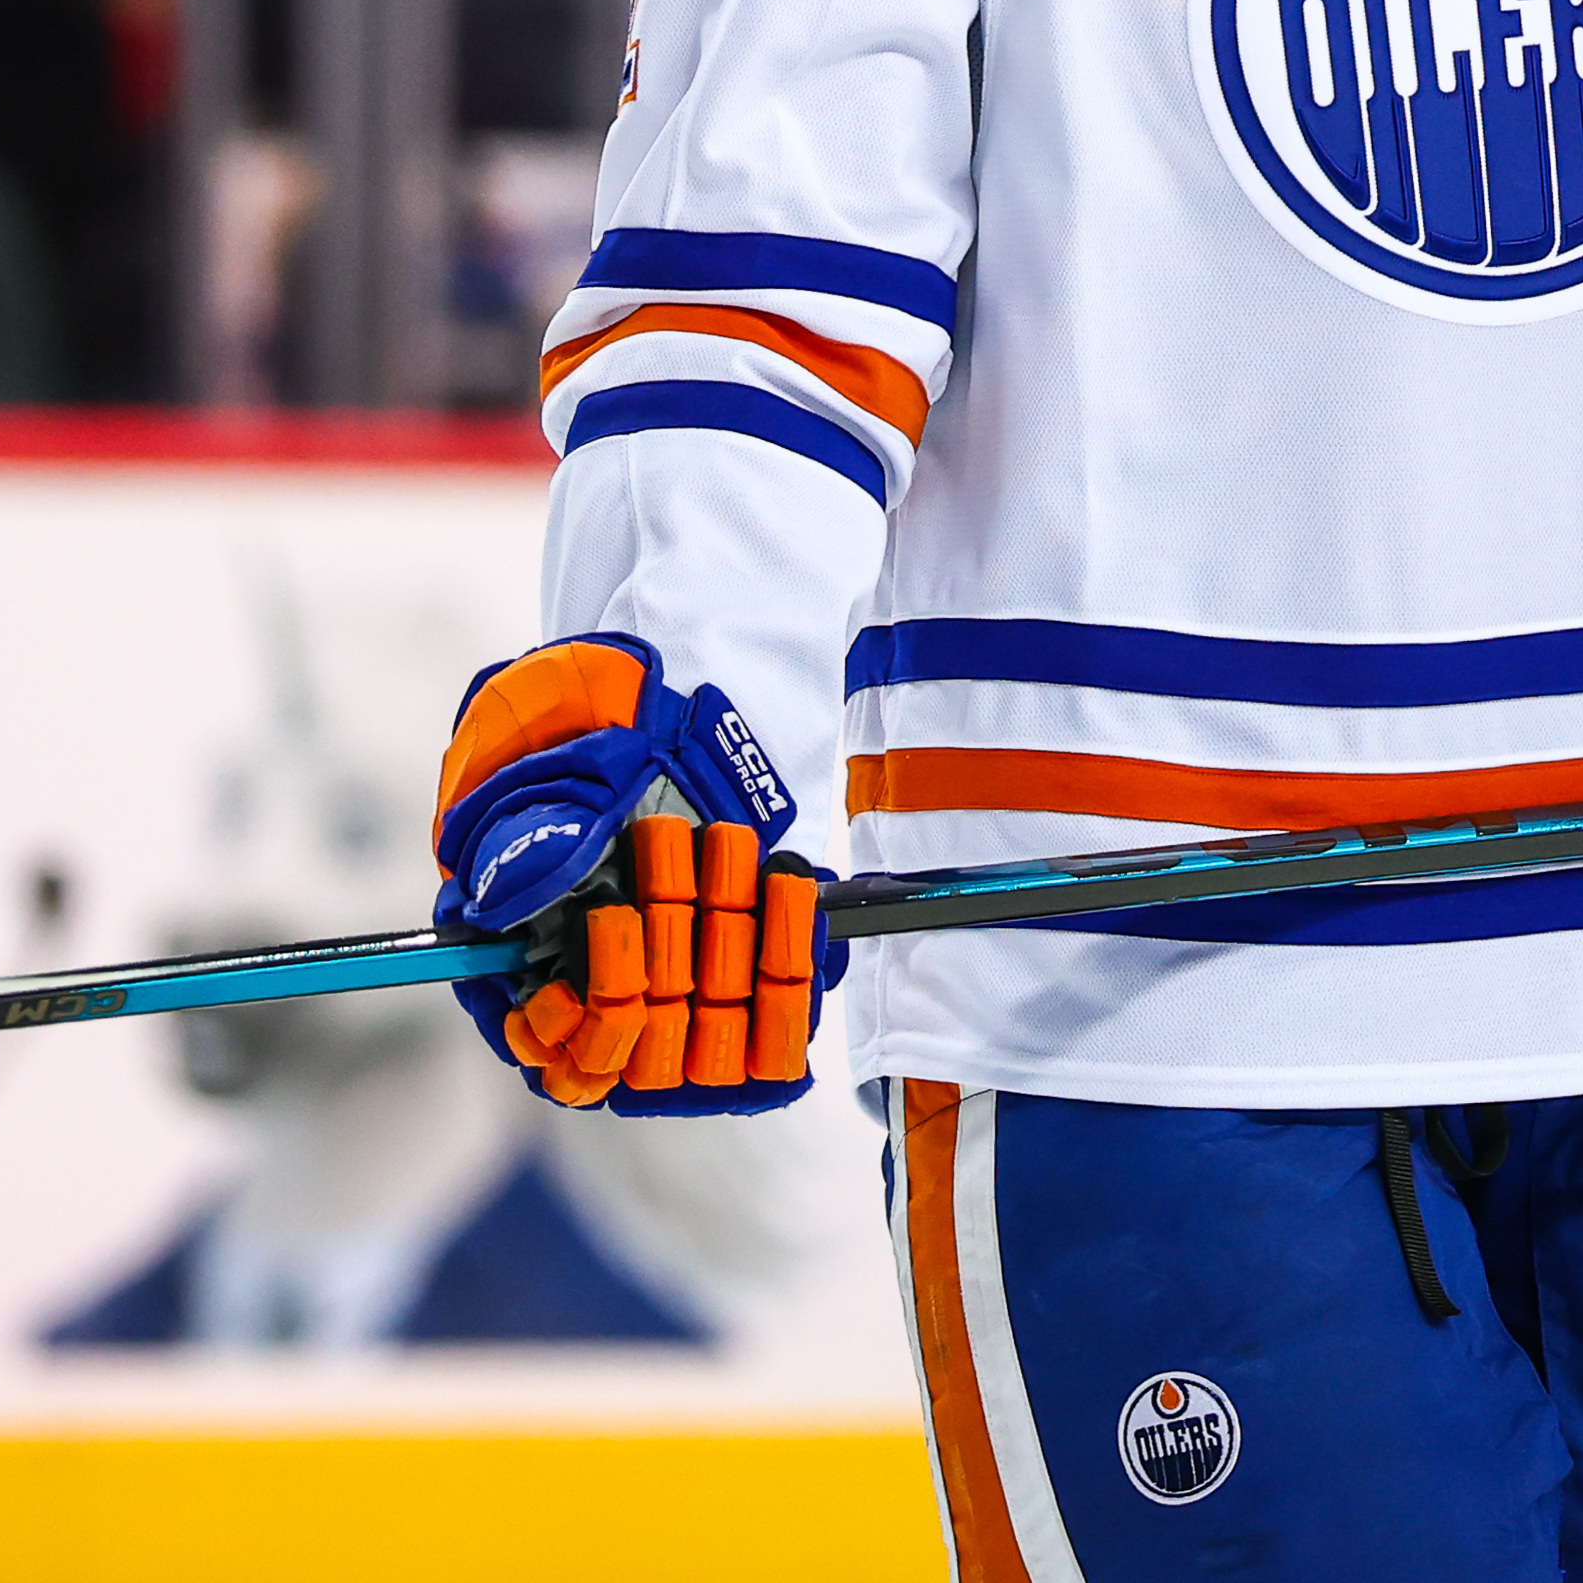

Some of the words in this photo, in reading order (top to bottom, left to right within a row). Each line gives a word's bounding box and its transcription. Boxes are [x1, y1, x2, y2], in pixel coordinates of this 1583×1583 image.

[722, 710, 788, 813] CCM
[729, 753, 757, 793] PRO
[476, 823, 581, 903] CCM
[4, 988, 127, 1027] CCM
[1134, 1412, 1223, 1493] OILERS
